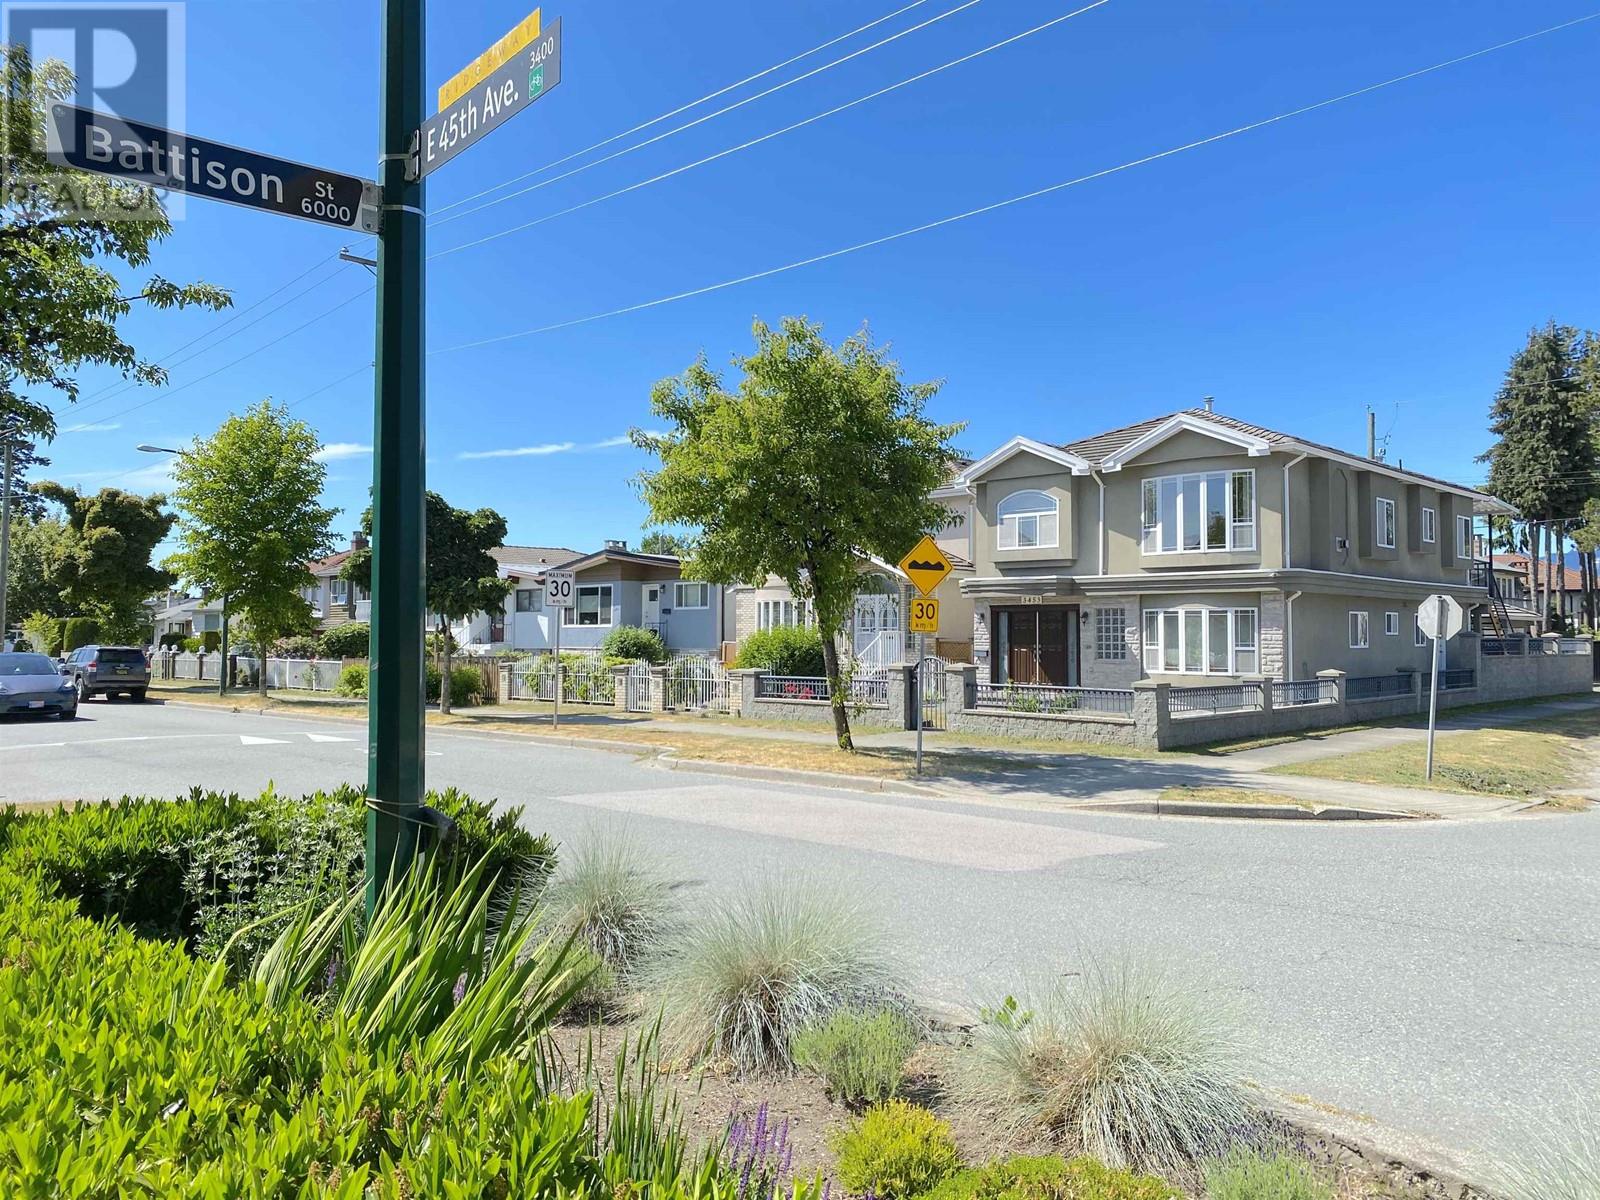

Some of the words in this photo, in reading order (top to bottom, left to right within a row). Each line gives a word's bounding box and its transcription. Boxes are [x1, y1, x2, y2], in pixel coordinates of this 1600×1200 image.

[444, 22, 532, 100] RIDGEWAY
[529, 36, 554, 69] 3400
[427, 127, 436, 163] E
[438, 98, 478, 152] 45th
[482, 79, 519, 124] Ave.
[84, 124, 284, 204] Battison
[314, 181, 335, 201] St
[300, 197, 351, 222] 6000
[549, 580, 571, 597] 30
[915, 602, 935, 619] 30
